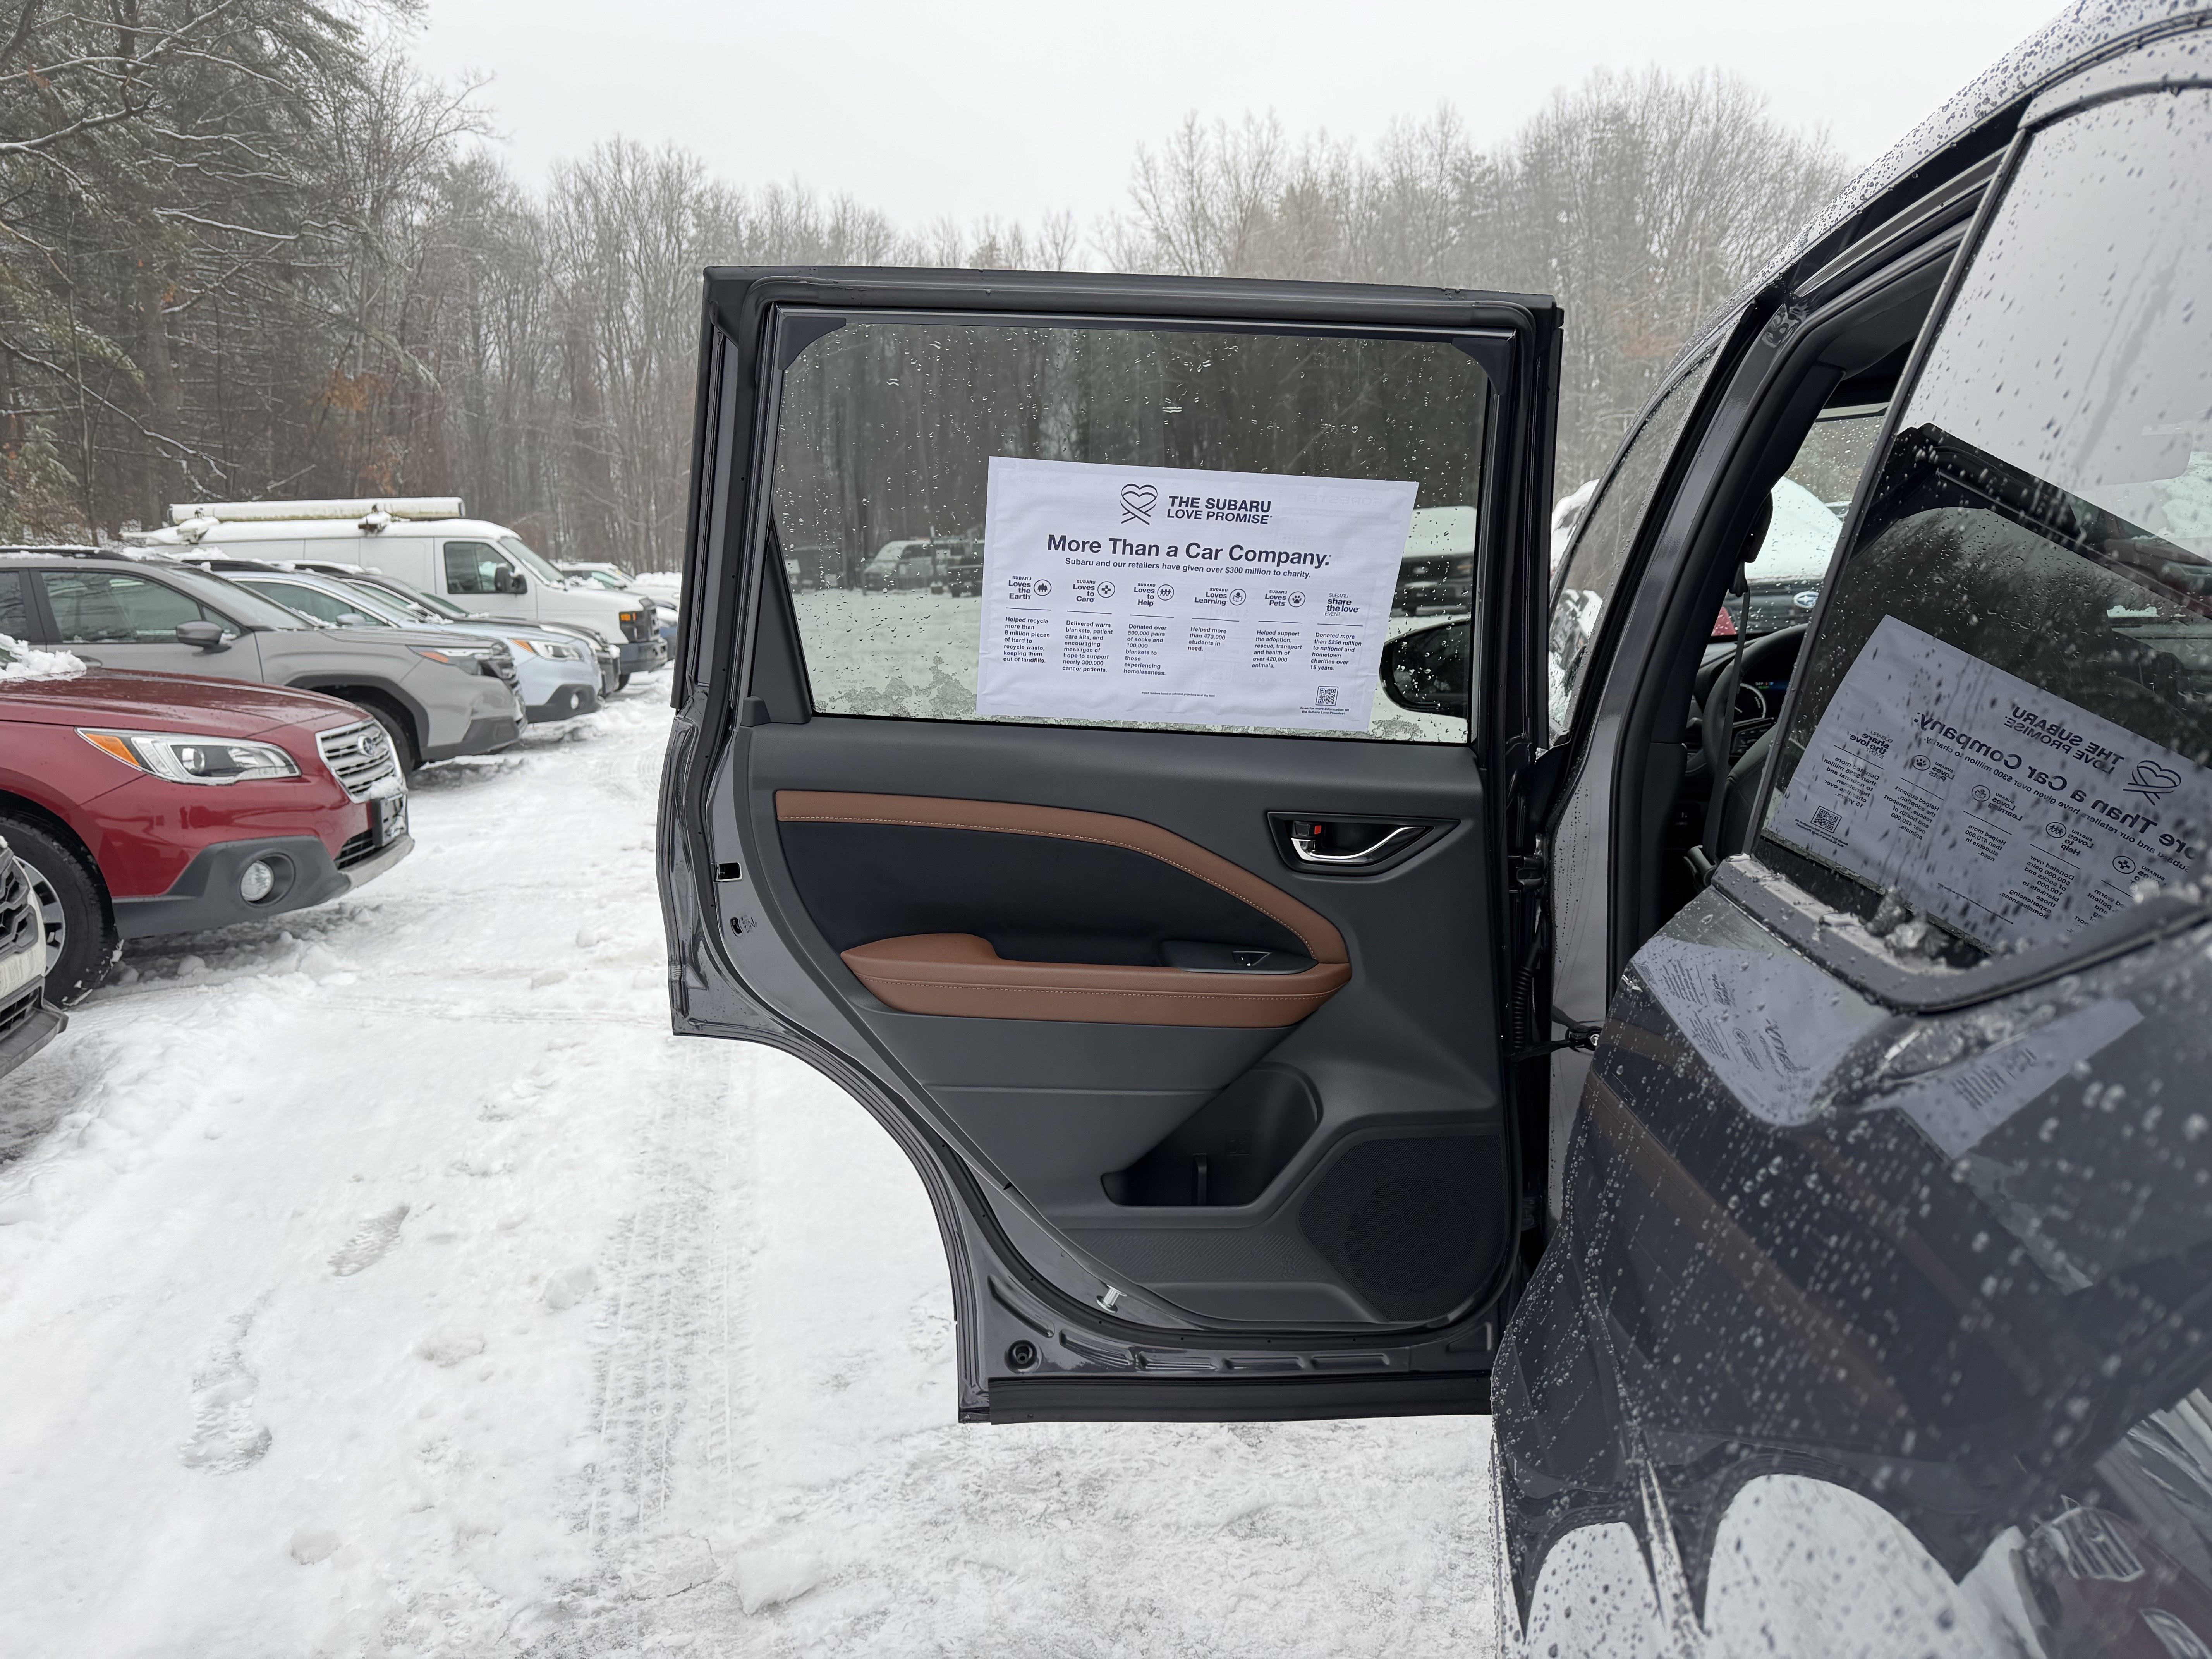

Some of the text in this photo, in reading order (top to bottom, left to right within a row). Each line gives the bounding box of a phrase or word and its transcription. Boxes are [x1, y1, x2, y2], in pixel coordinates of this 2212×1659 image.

[1169, 496, 1271, 513] THE SUBARU
[1167, 508, 1269, 524] LOVE PROMISE
[1048, 534, 1328, 569] More Than a Car Company.
[1065, 557, 1094, 566] Subaru
[1182, 564, 1204, 572] given
[1283, 570, 1310, 579] charity.
[1137, 599, 1154, 607] Help
[1194, 597, 1226, 606] Learning
[1341, 605, 1358, 613] love
